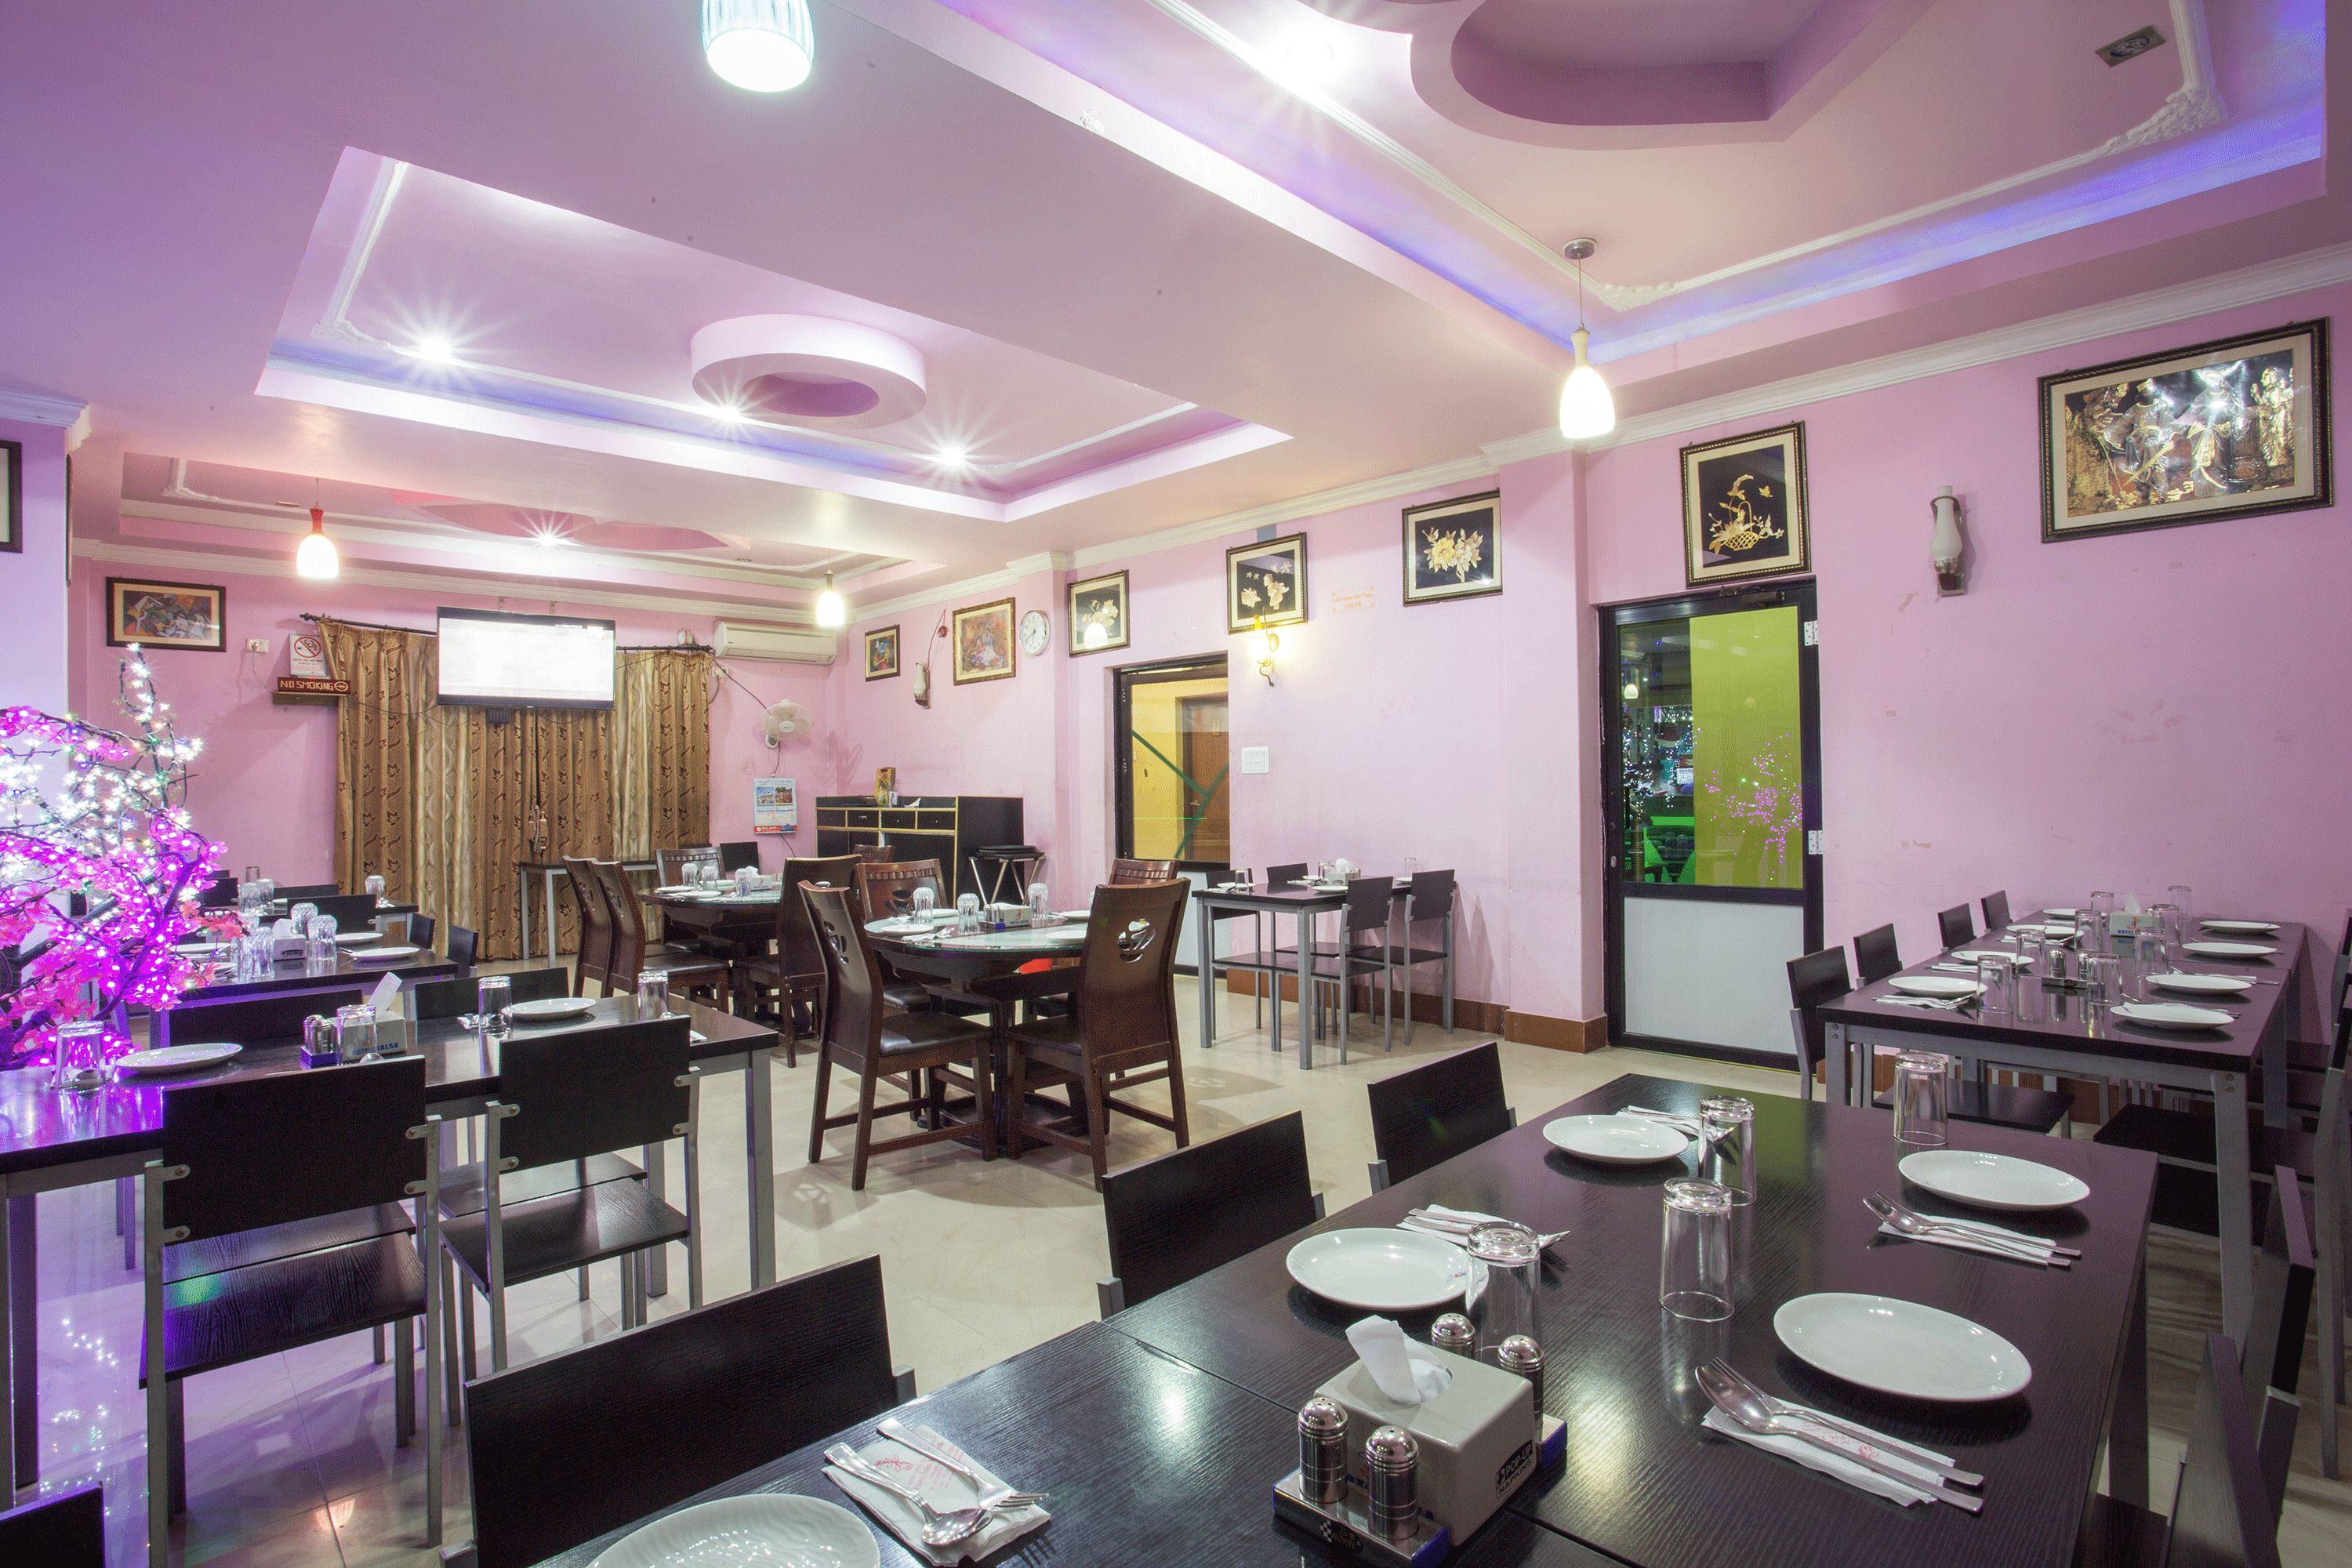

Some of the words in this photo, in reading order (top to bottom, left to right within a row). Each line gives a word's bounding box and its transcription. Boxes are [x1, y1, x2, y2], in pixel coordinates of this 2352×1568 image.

[280, 680, 295, 688] NO
[296, 681, 334, 691] SMOKING
[1499, 1458, 1532, 1494] NAPKINS
[1506, 1443, 1532, 1476] POP-UP
